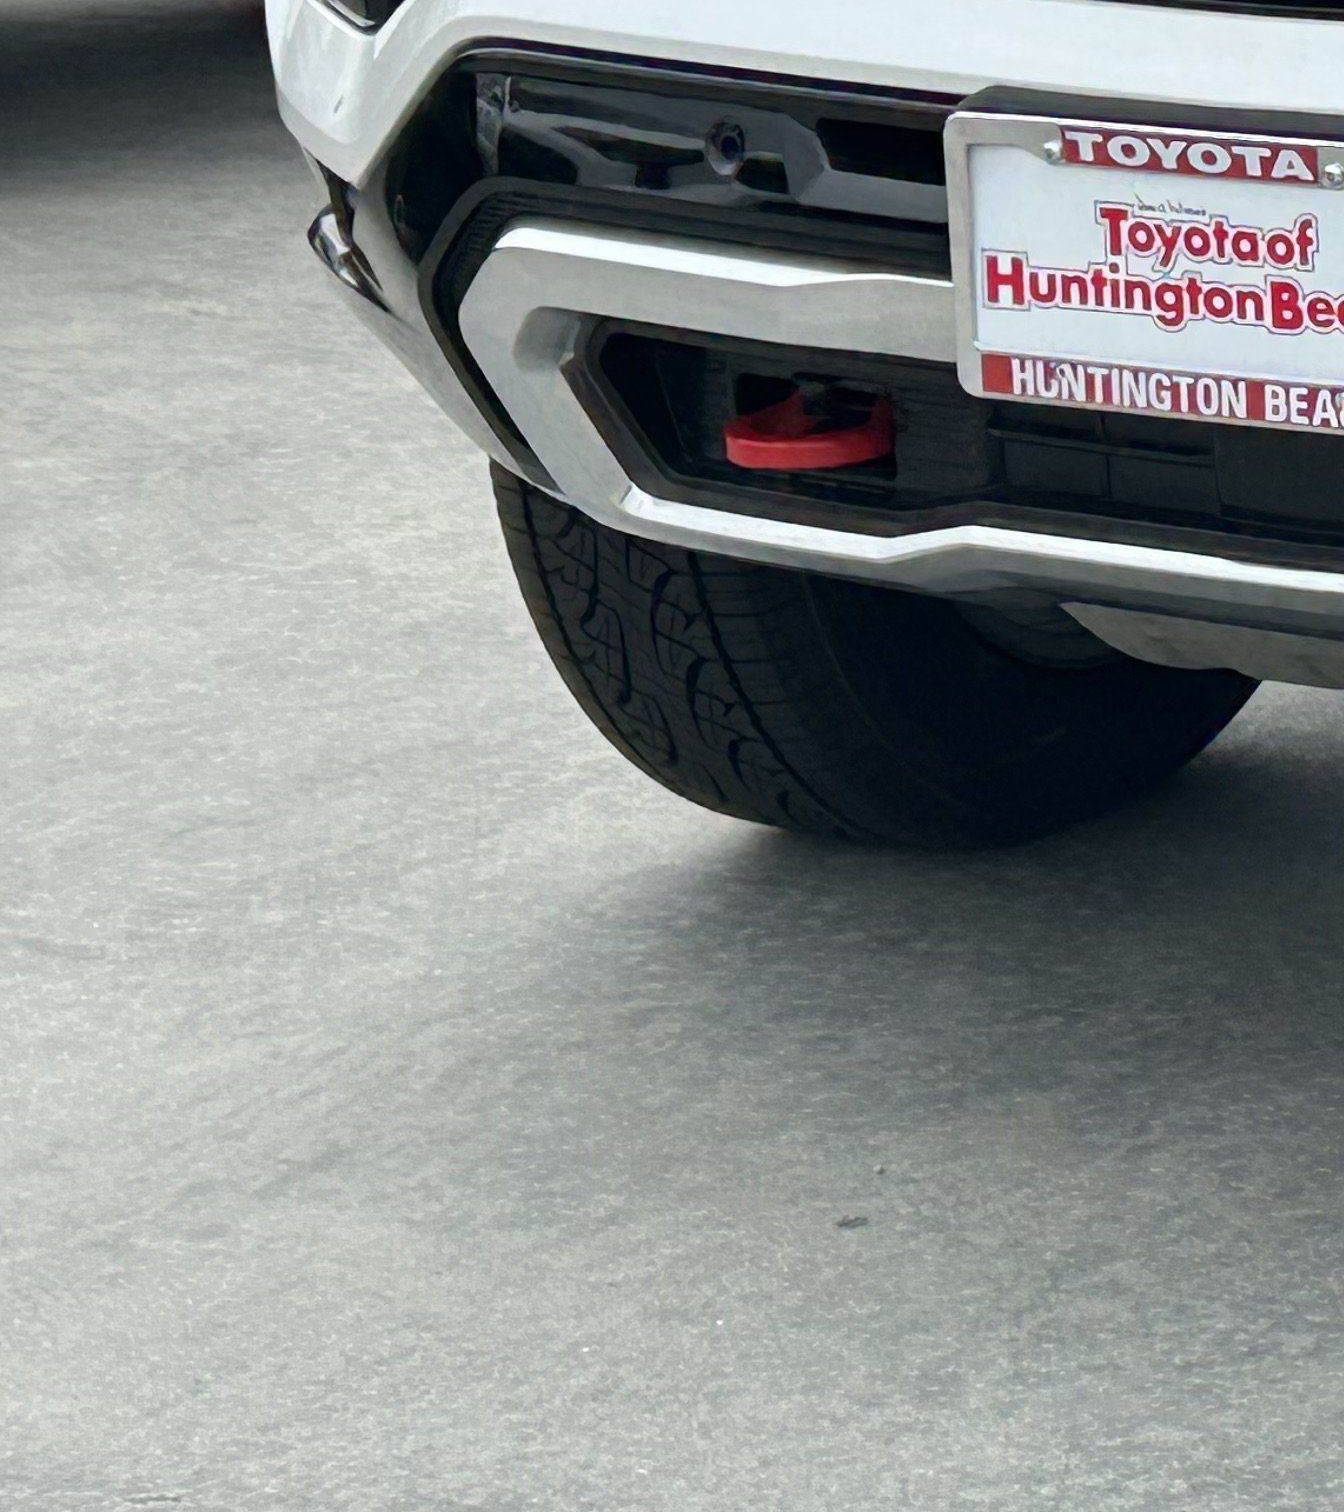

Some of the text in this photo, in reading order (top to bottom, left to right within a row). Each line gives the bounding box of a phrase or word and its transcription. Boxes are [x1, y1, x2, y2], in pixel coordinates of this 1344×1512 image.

[1065, 130, 1316, 182] TOYOTA
[1099, 207, 1315, 269] Toyota of
[986, 254, 1264, 326] Huntington
[1010, 357, 1248, 419] HUNTINGTON
